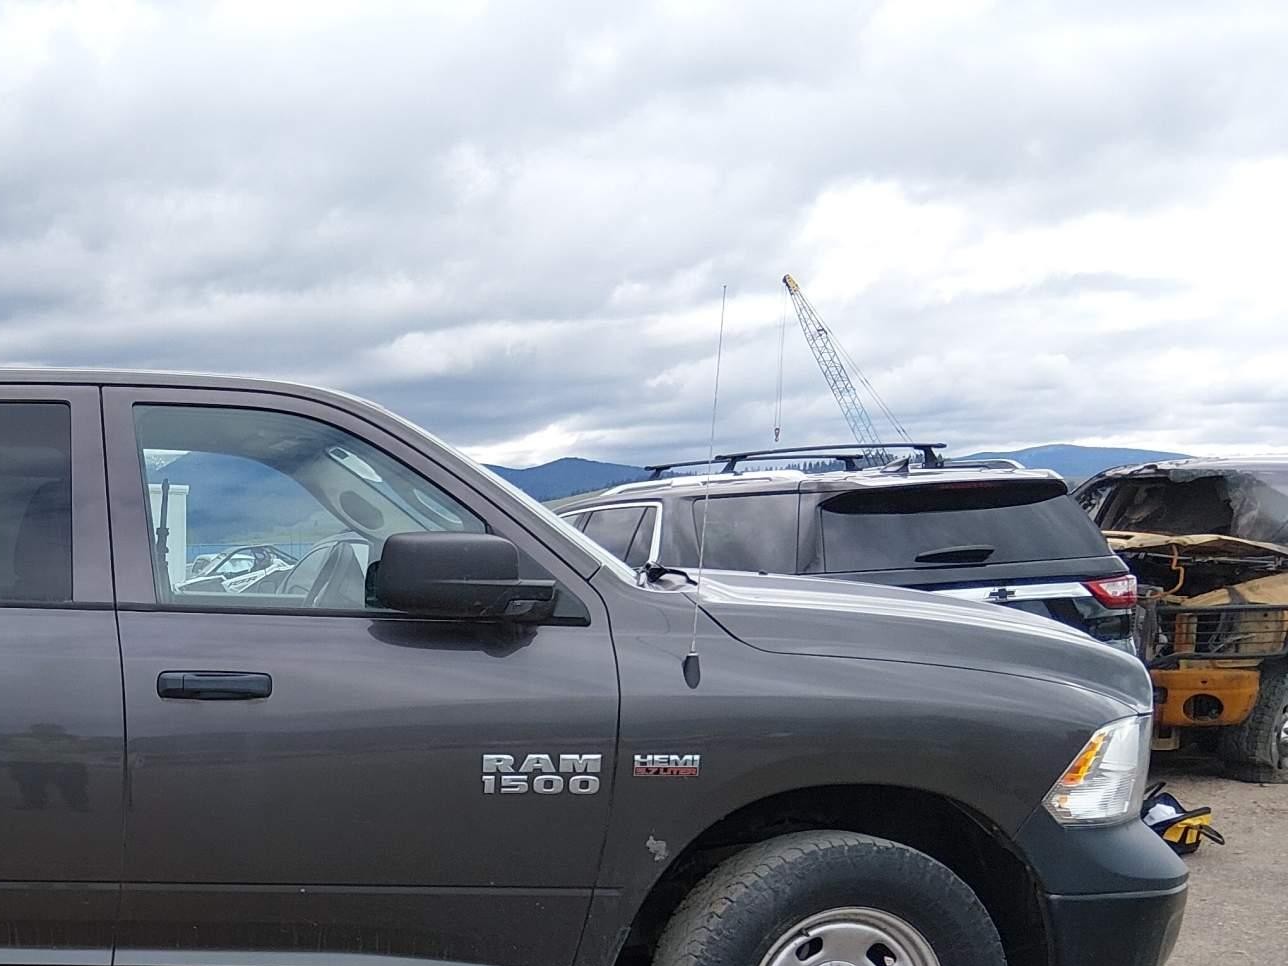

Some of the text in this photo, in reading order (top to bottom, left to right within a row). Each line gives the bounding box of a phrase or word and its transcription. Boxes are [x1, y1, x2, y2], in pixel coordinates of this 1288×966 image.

[482, 754, 602, 773] RAM
[634, 754, 701, 767] HEMI
[482, 775, 601, 795] 1500
